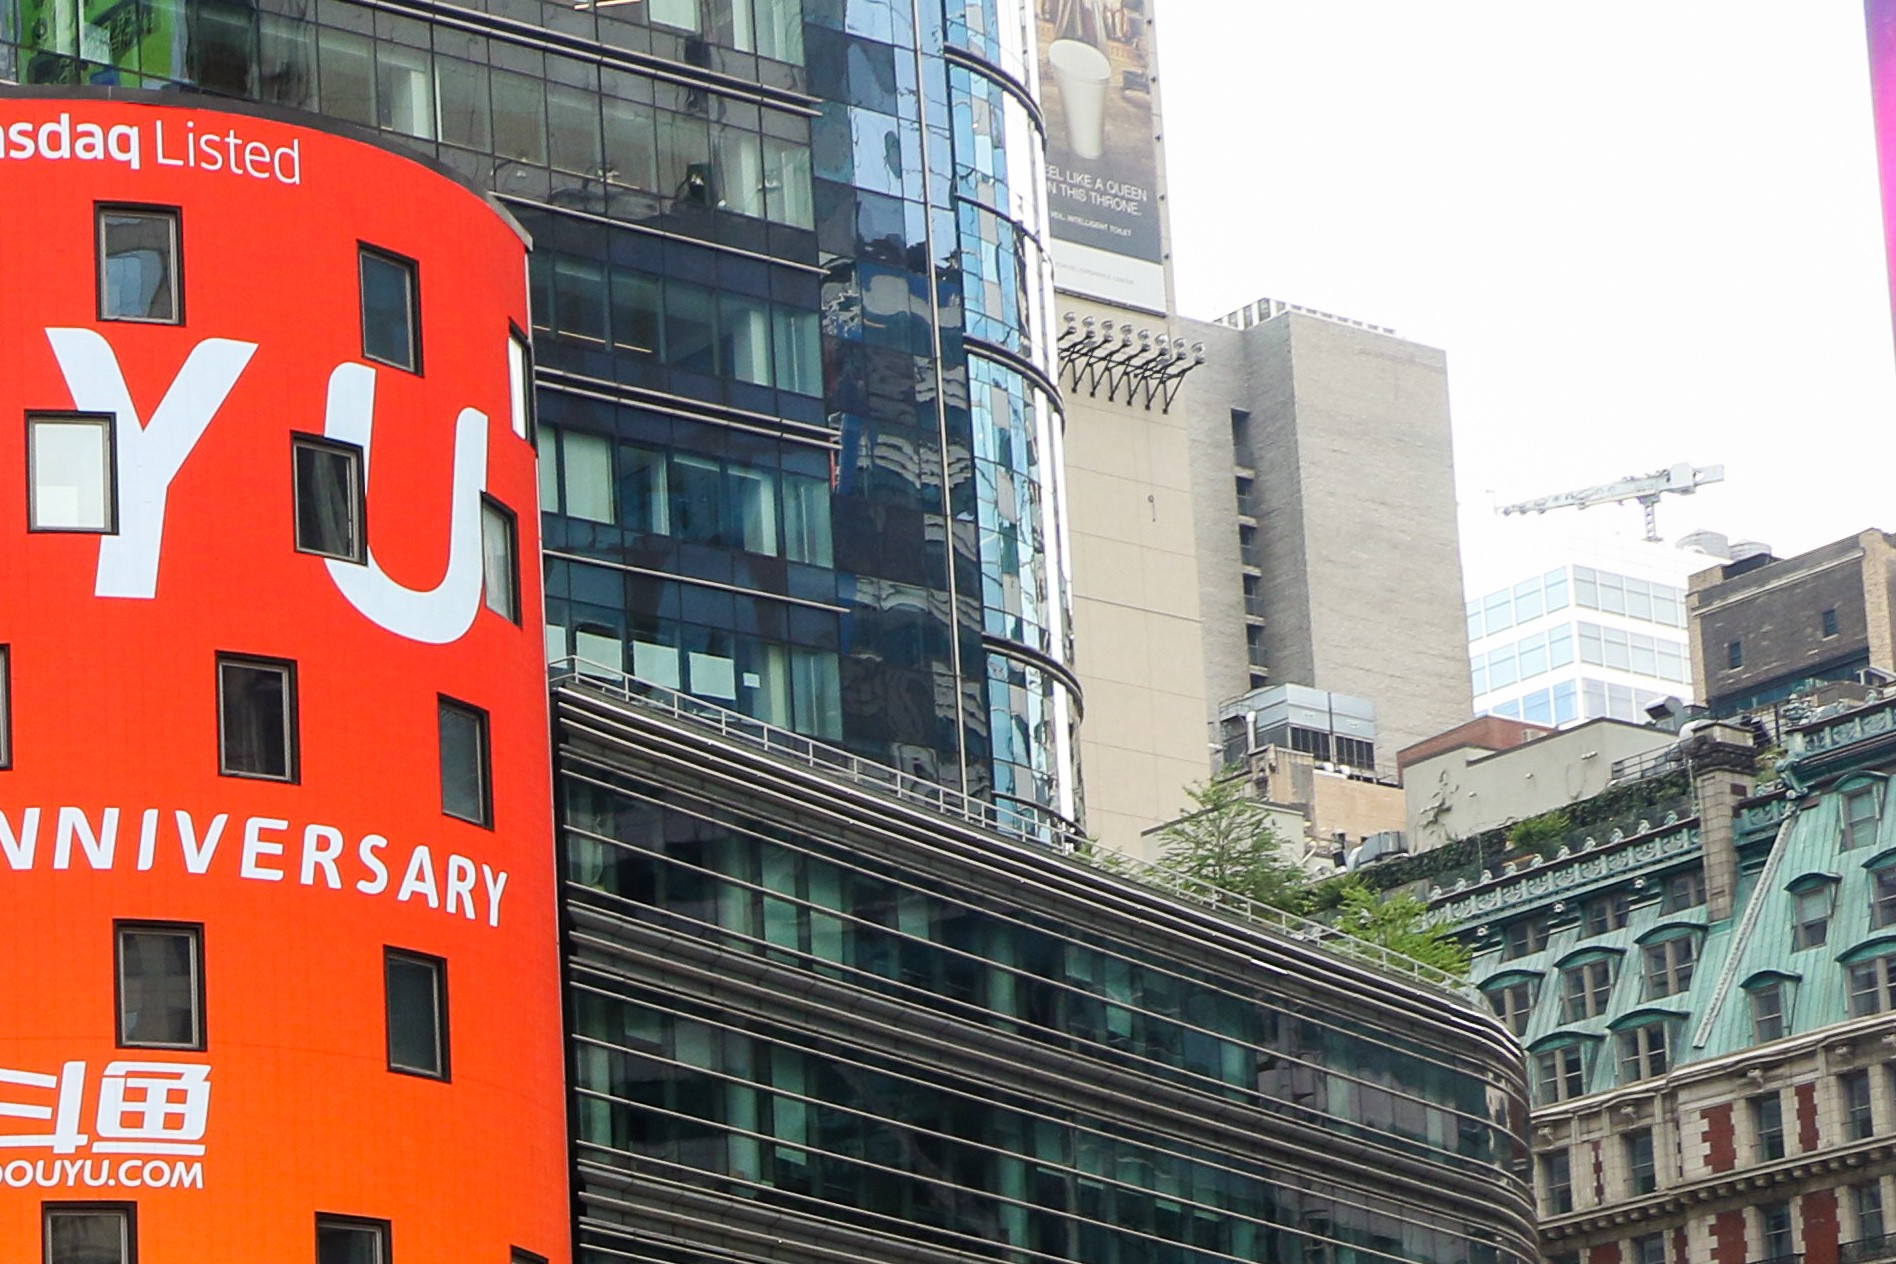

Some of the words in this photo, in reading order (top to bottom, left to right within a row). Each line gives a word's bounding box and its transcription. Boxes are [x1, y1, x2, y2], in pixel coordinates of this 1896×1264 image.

[155, 119, 301, 186] Listed
[1059, 183, 1087, 203] THIS
[1067, 170, 1093, 189] LIKE
[1095, 178, 1104, 192] A
[1106, 180, 1147, 202] QUEEN
